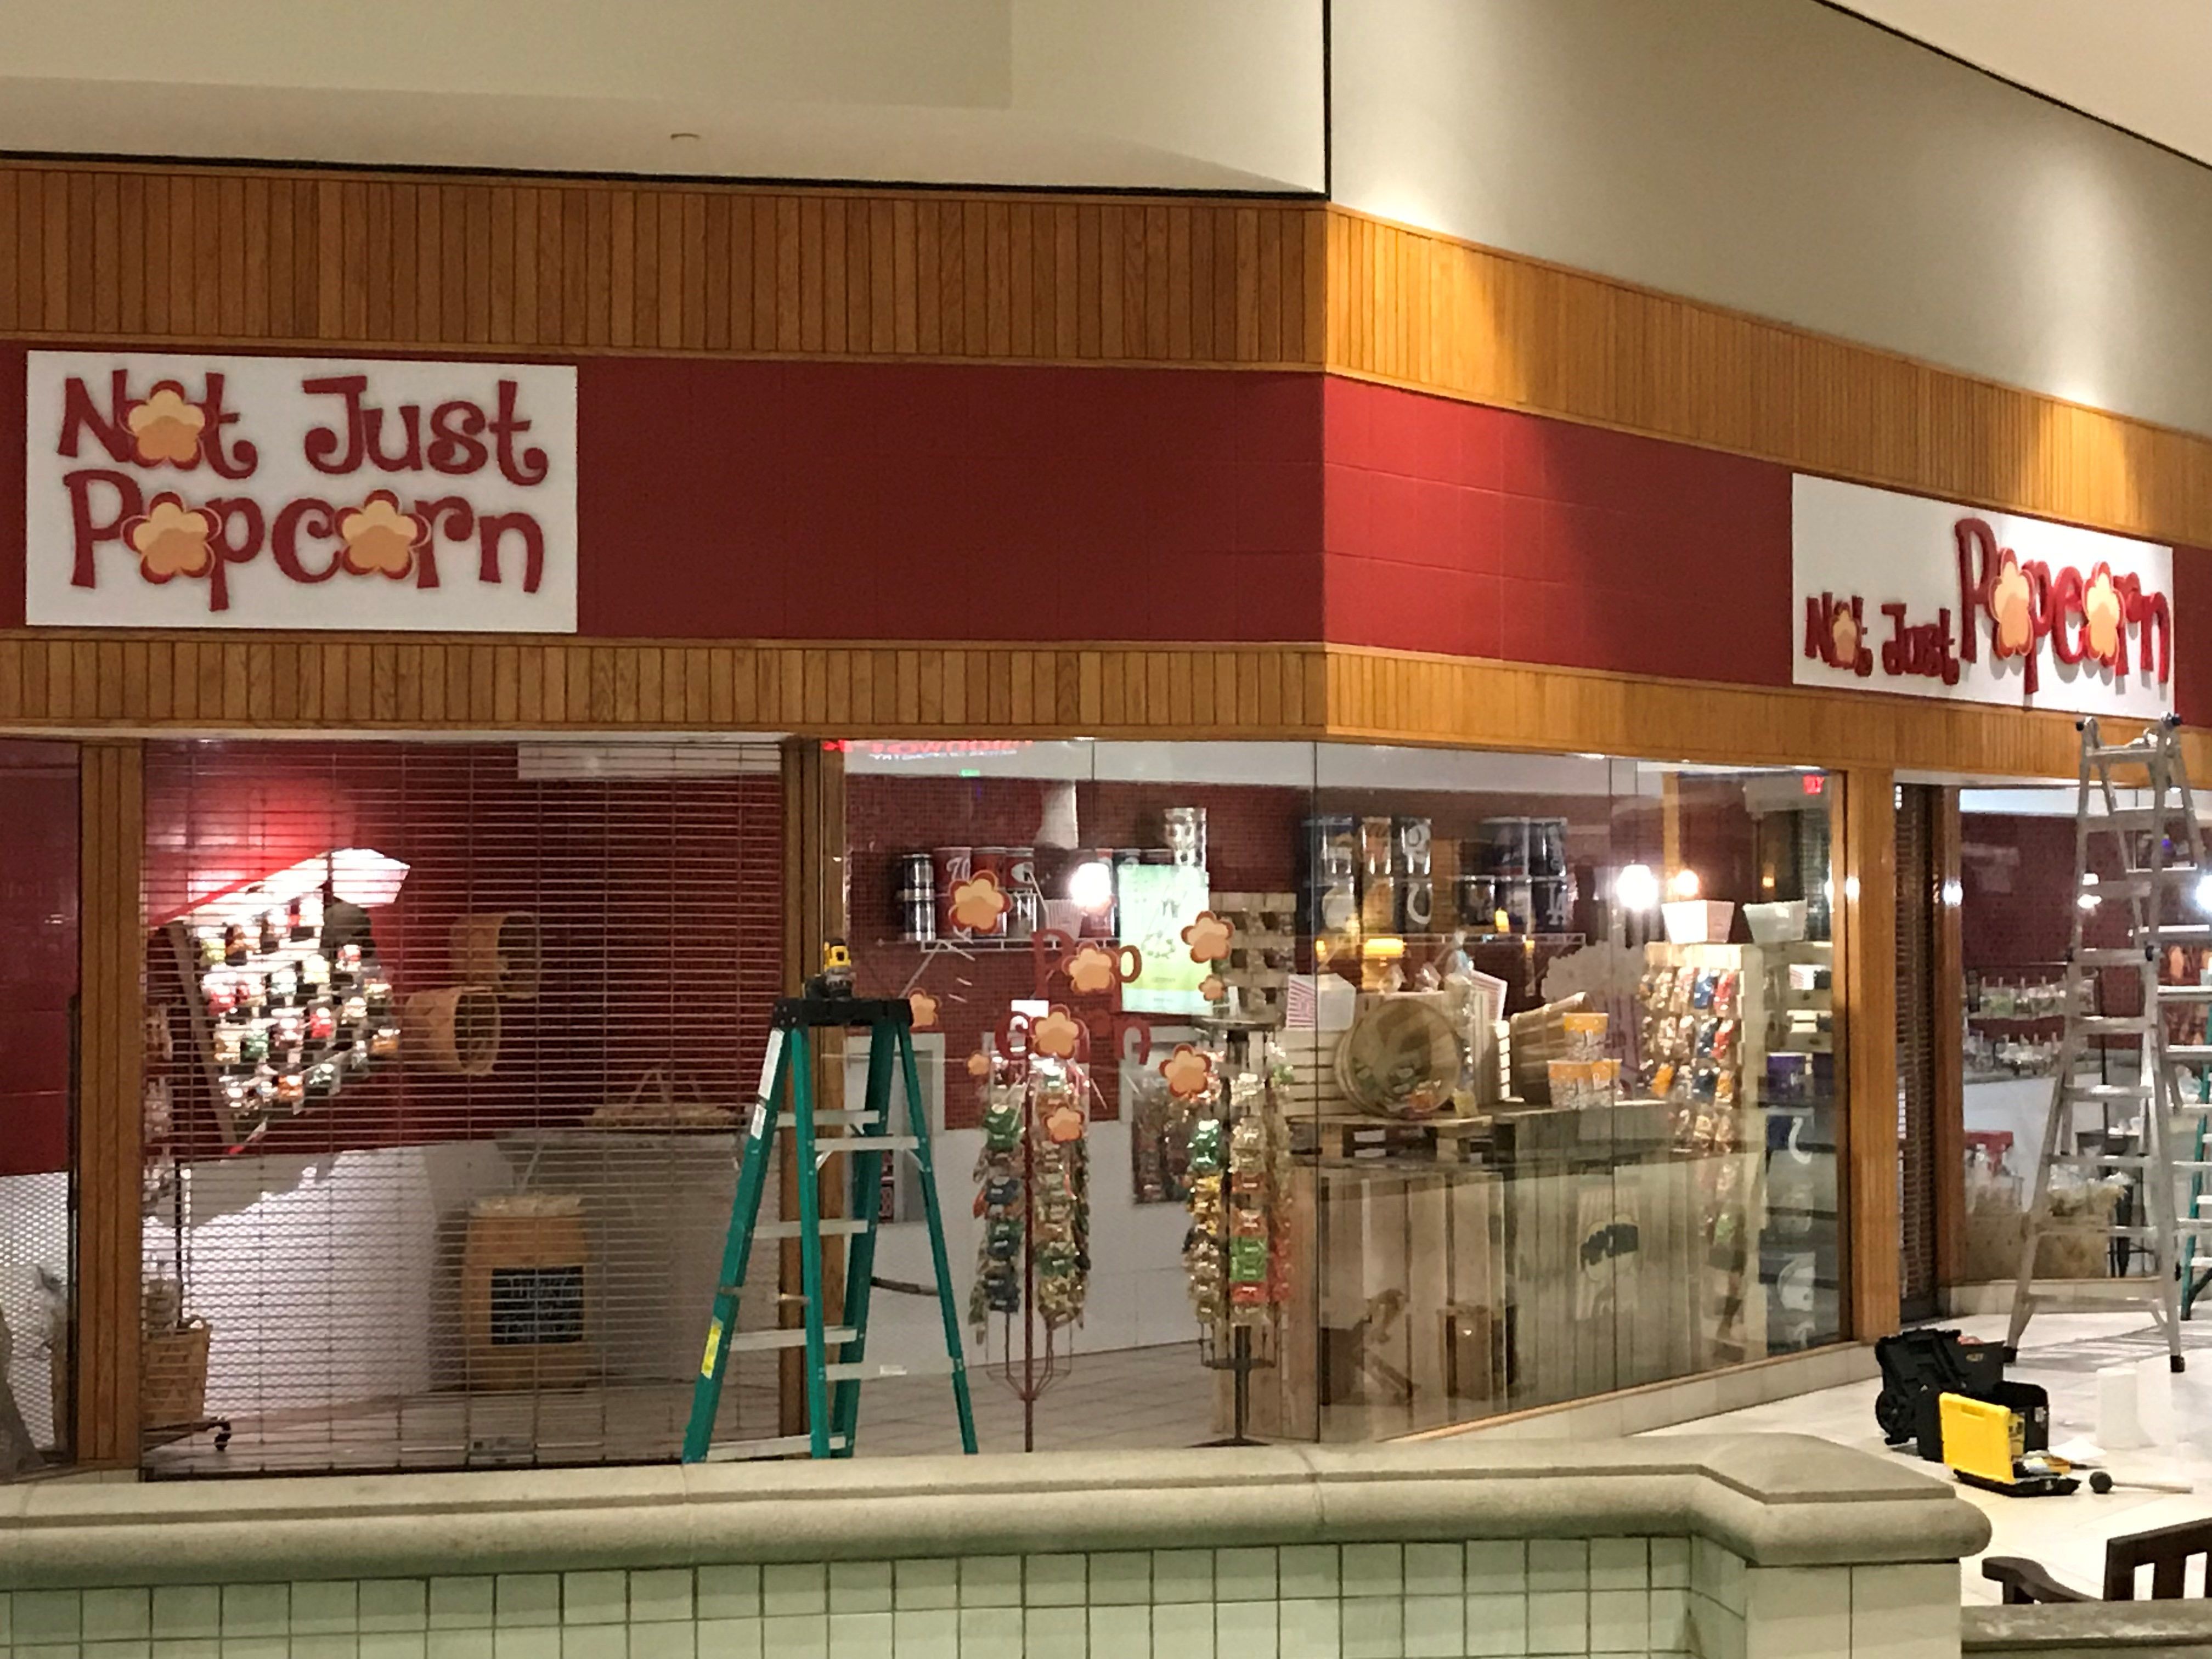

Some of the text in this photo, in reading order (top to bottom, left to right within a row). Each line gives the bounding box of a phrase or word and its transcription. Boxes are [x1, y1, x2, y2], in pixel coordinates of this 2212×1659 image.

[57, 369, 549, 486] Not Just
[63, 469, 545, 612] Popcorn
[1804, 517, 2170, 695] Not Just Popcorn
